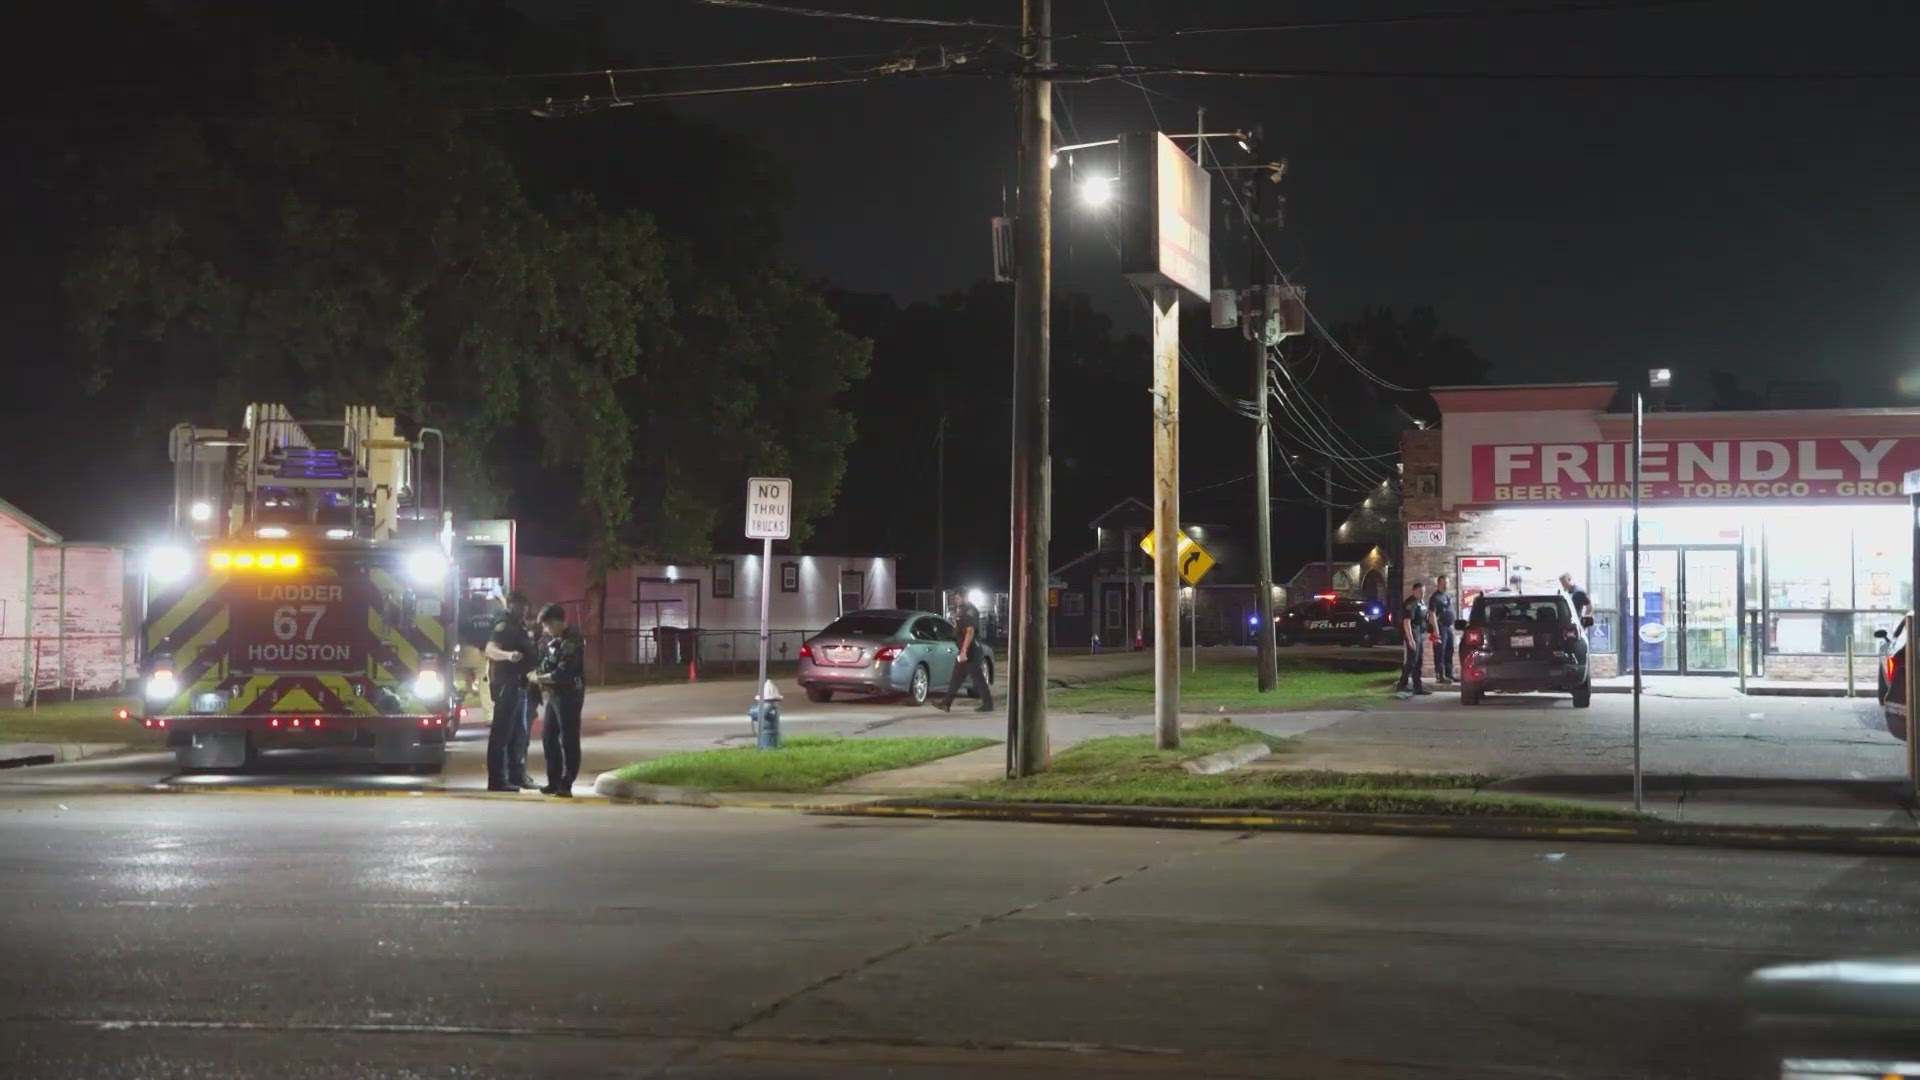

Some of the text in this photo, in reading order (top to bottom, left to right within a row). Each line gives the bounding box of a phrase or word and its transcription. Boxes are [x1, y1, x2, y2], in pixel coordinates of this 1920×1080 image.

[1494, 439, 1899, 485] FRIENDLY
[758, 485, 780, 499] NO
[1495, 485, 1562, 500] BEER
[1585, 483, 1653, 499] WINE
[1679, 481, 1810, 498] TOBACCO
[1836, 481, 1904, 497] GRO
[753, 503, 784, 515] THRU
[752, 519, 785, 532] TRUCKS
[257, 585, 342, 601] LADDER
[273, 605, 327, 640] 67
[1310, 621, 1357, 630] POLICE
[248, 645, 351, 660] HOUSTON
